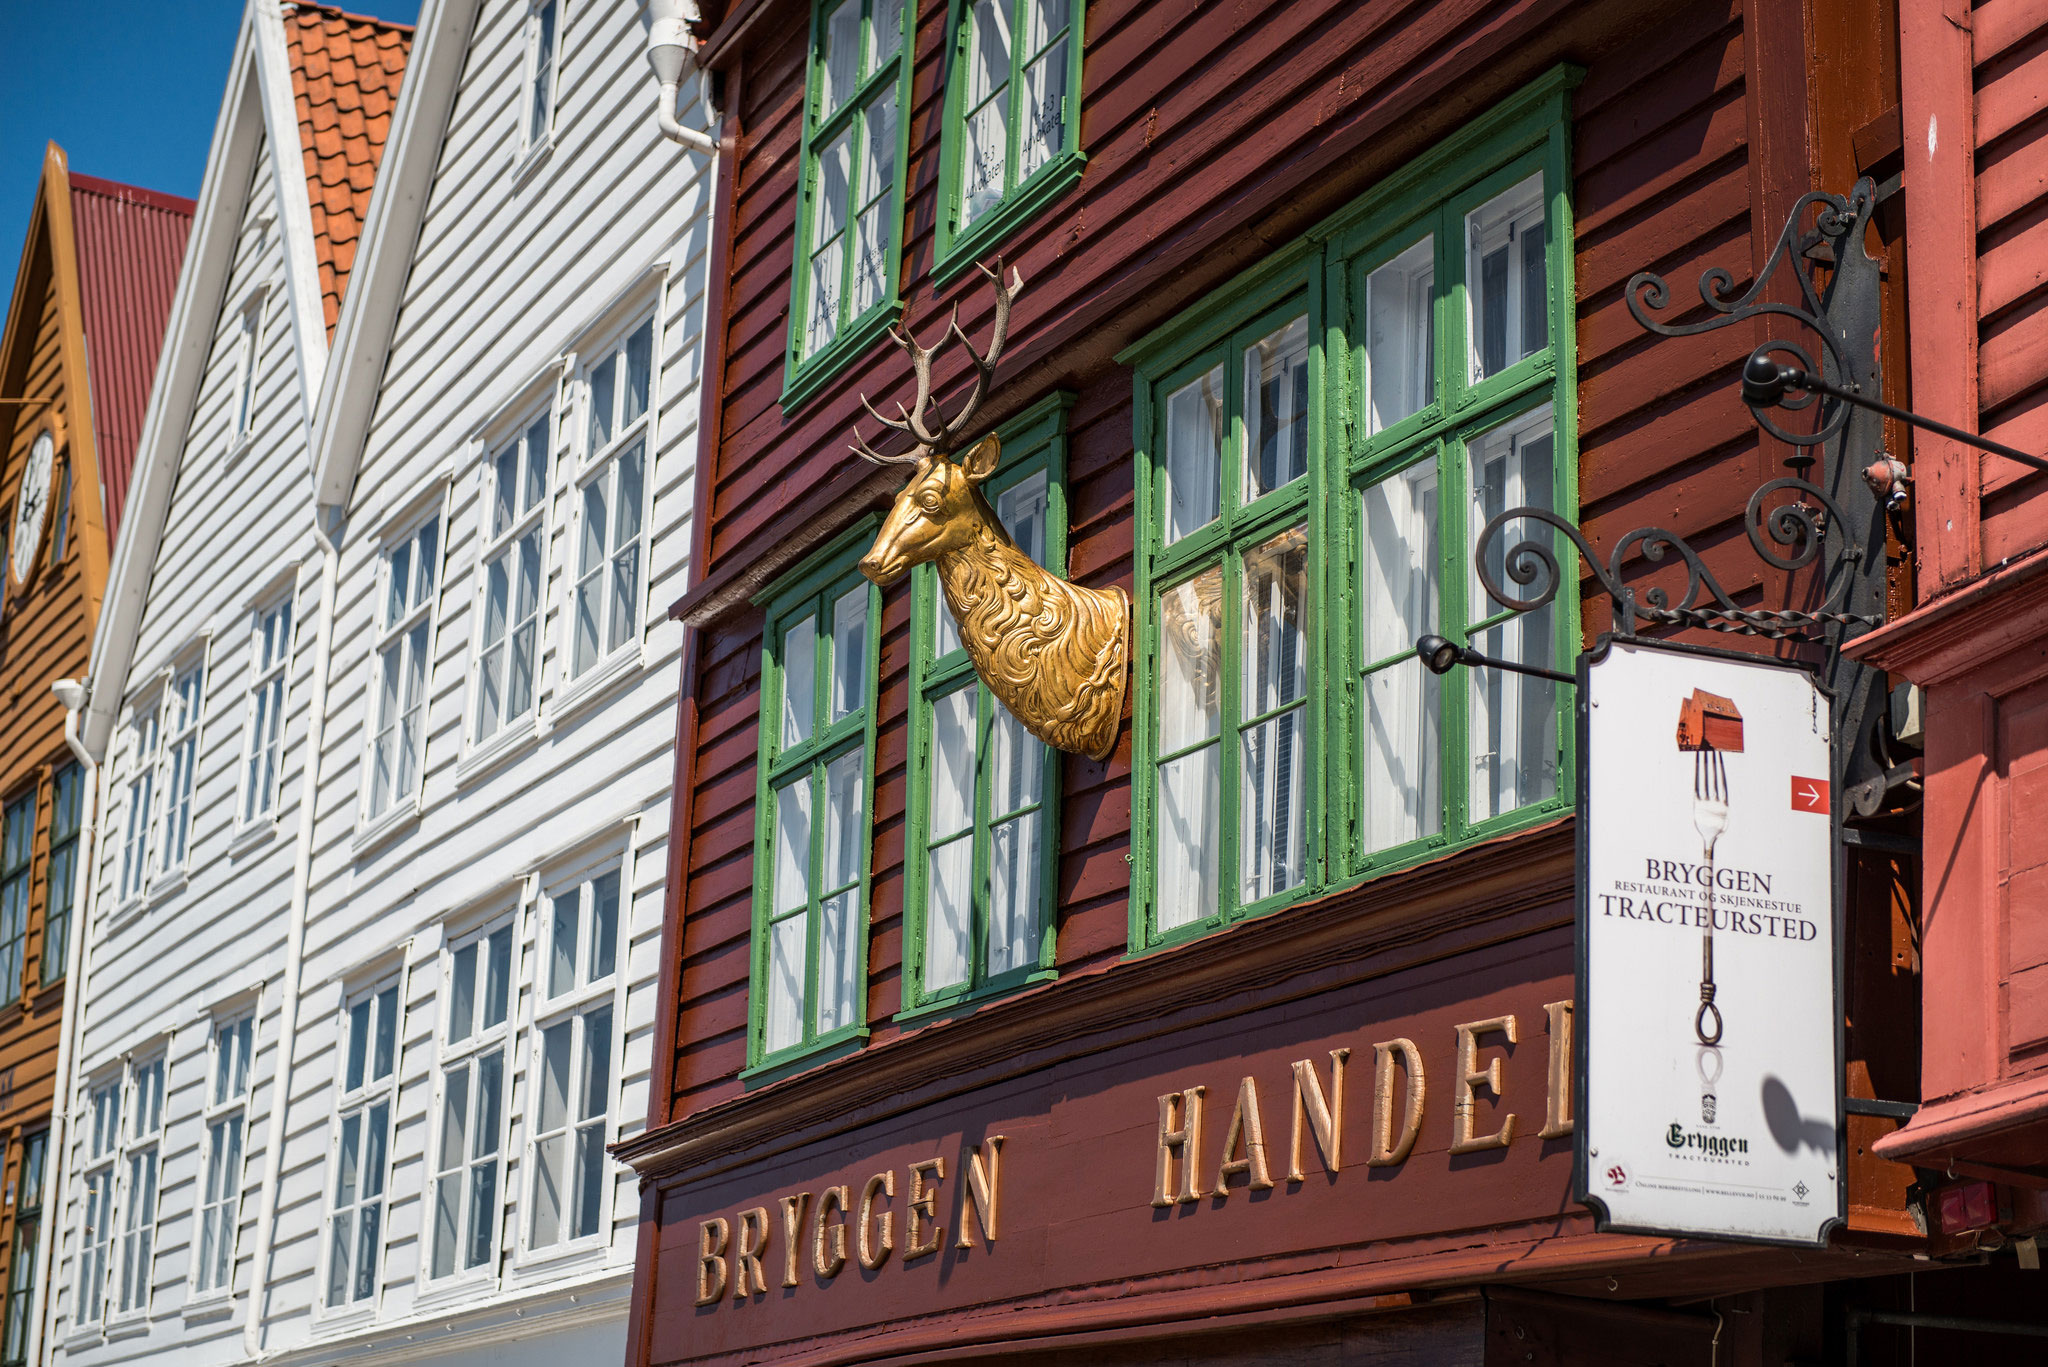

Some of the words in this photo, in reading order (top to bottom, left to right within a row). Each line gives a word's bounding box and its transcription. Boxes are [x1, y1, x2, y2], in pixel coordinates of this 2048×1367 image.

[1022, 112, 1061, 156] Advokate
[1646, 857, 1772, 895] BRYGGEN
[1599, 893, 1817, 942] TRACTEURSTED
[1614, 880, 1695, 900] RESTAURANT
[1699, 891, 1716, 903] OG
[1720, 894, 1801, 914] SKJENKESTUE
[1668, 1152, 1750, 1167] TRACTEURSTED
[694, 1135, 1004, 1307] BRYGGEN
